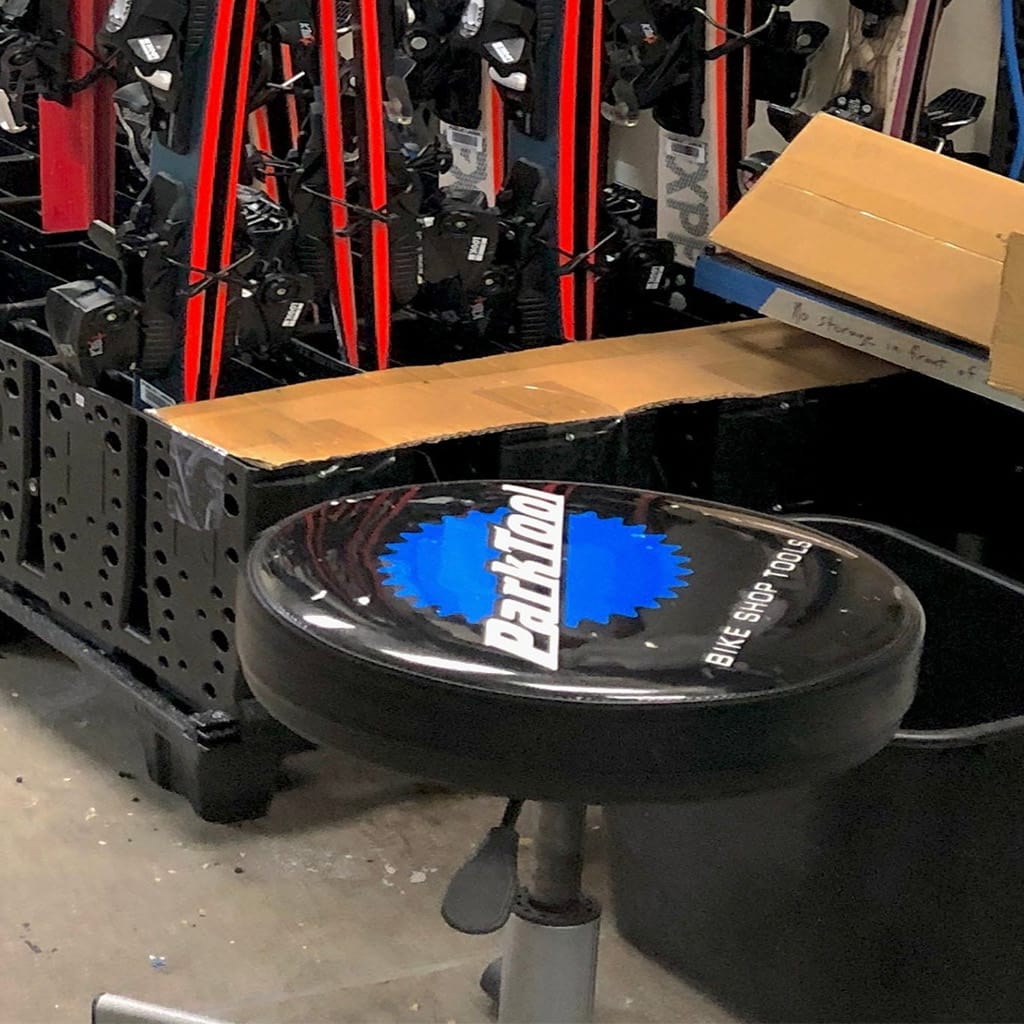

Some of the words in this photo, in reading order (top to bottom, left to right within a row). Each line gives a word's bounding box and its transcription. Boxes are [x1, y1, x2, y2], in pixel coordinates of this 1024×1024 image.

[484, 483, 565, 672] ParkTool
[705, 625, 751, 670] BIKE
[741, 581, 778, 624] SHOP
[763, 537, 814, 580] TOOLS
